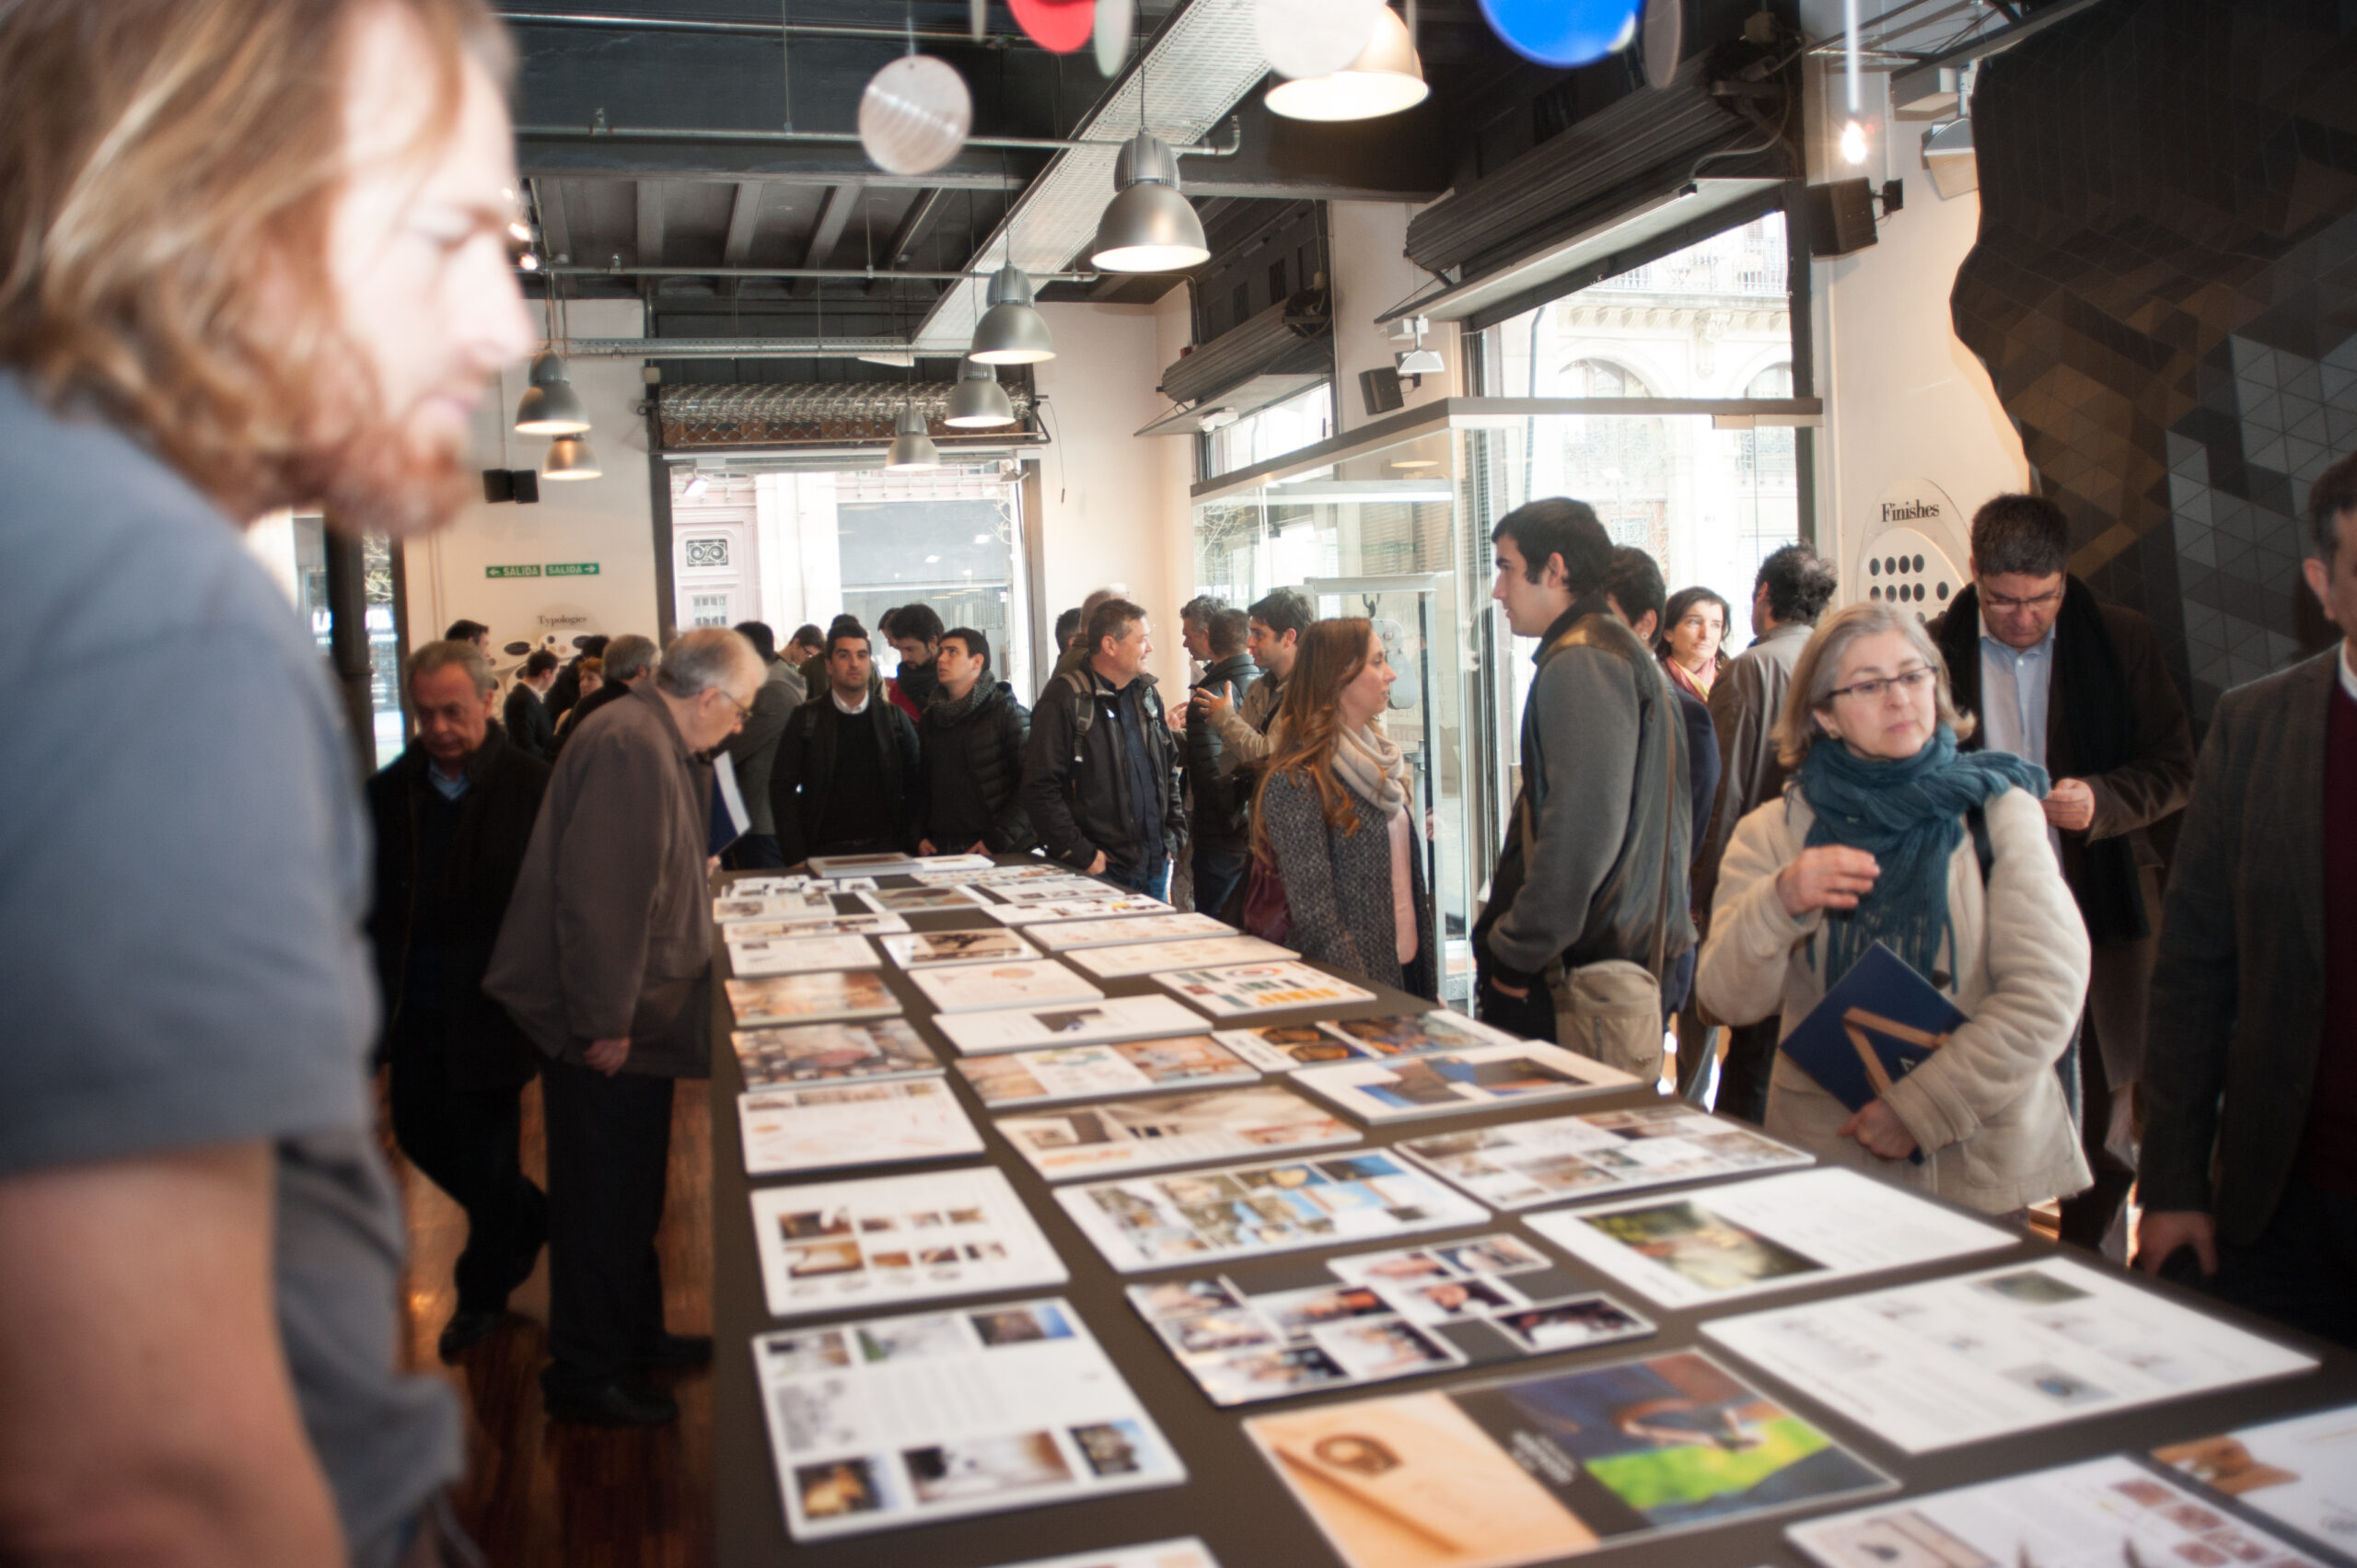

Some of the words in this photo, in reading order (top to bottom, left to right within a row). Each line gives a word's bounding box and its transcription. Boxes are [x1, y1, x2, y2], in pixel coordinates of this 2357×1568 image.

[1881, 499, 1940, 523] Finishes
[503, 566, 539, 576] SALIDA
[548, 564, 583, 575] SALIDA
[539, 615, 586, 626] Typologies
